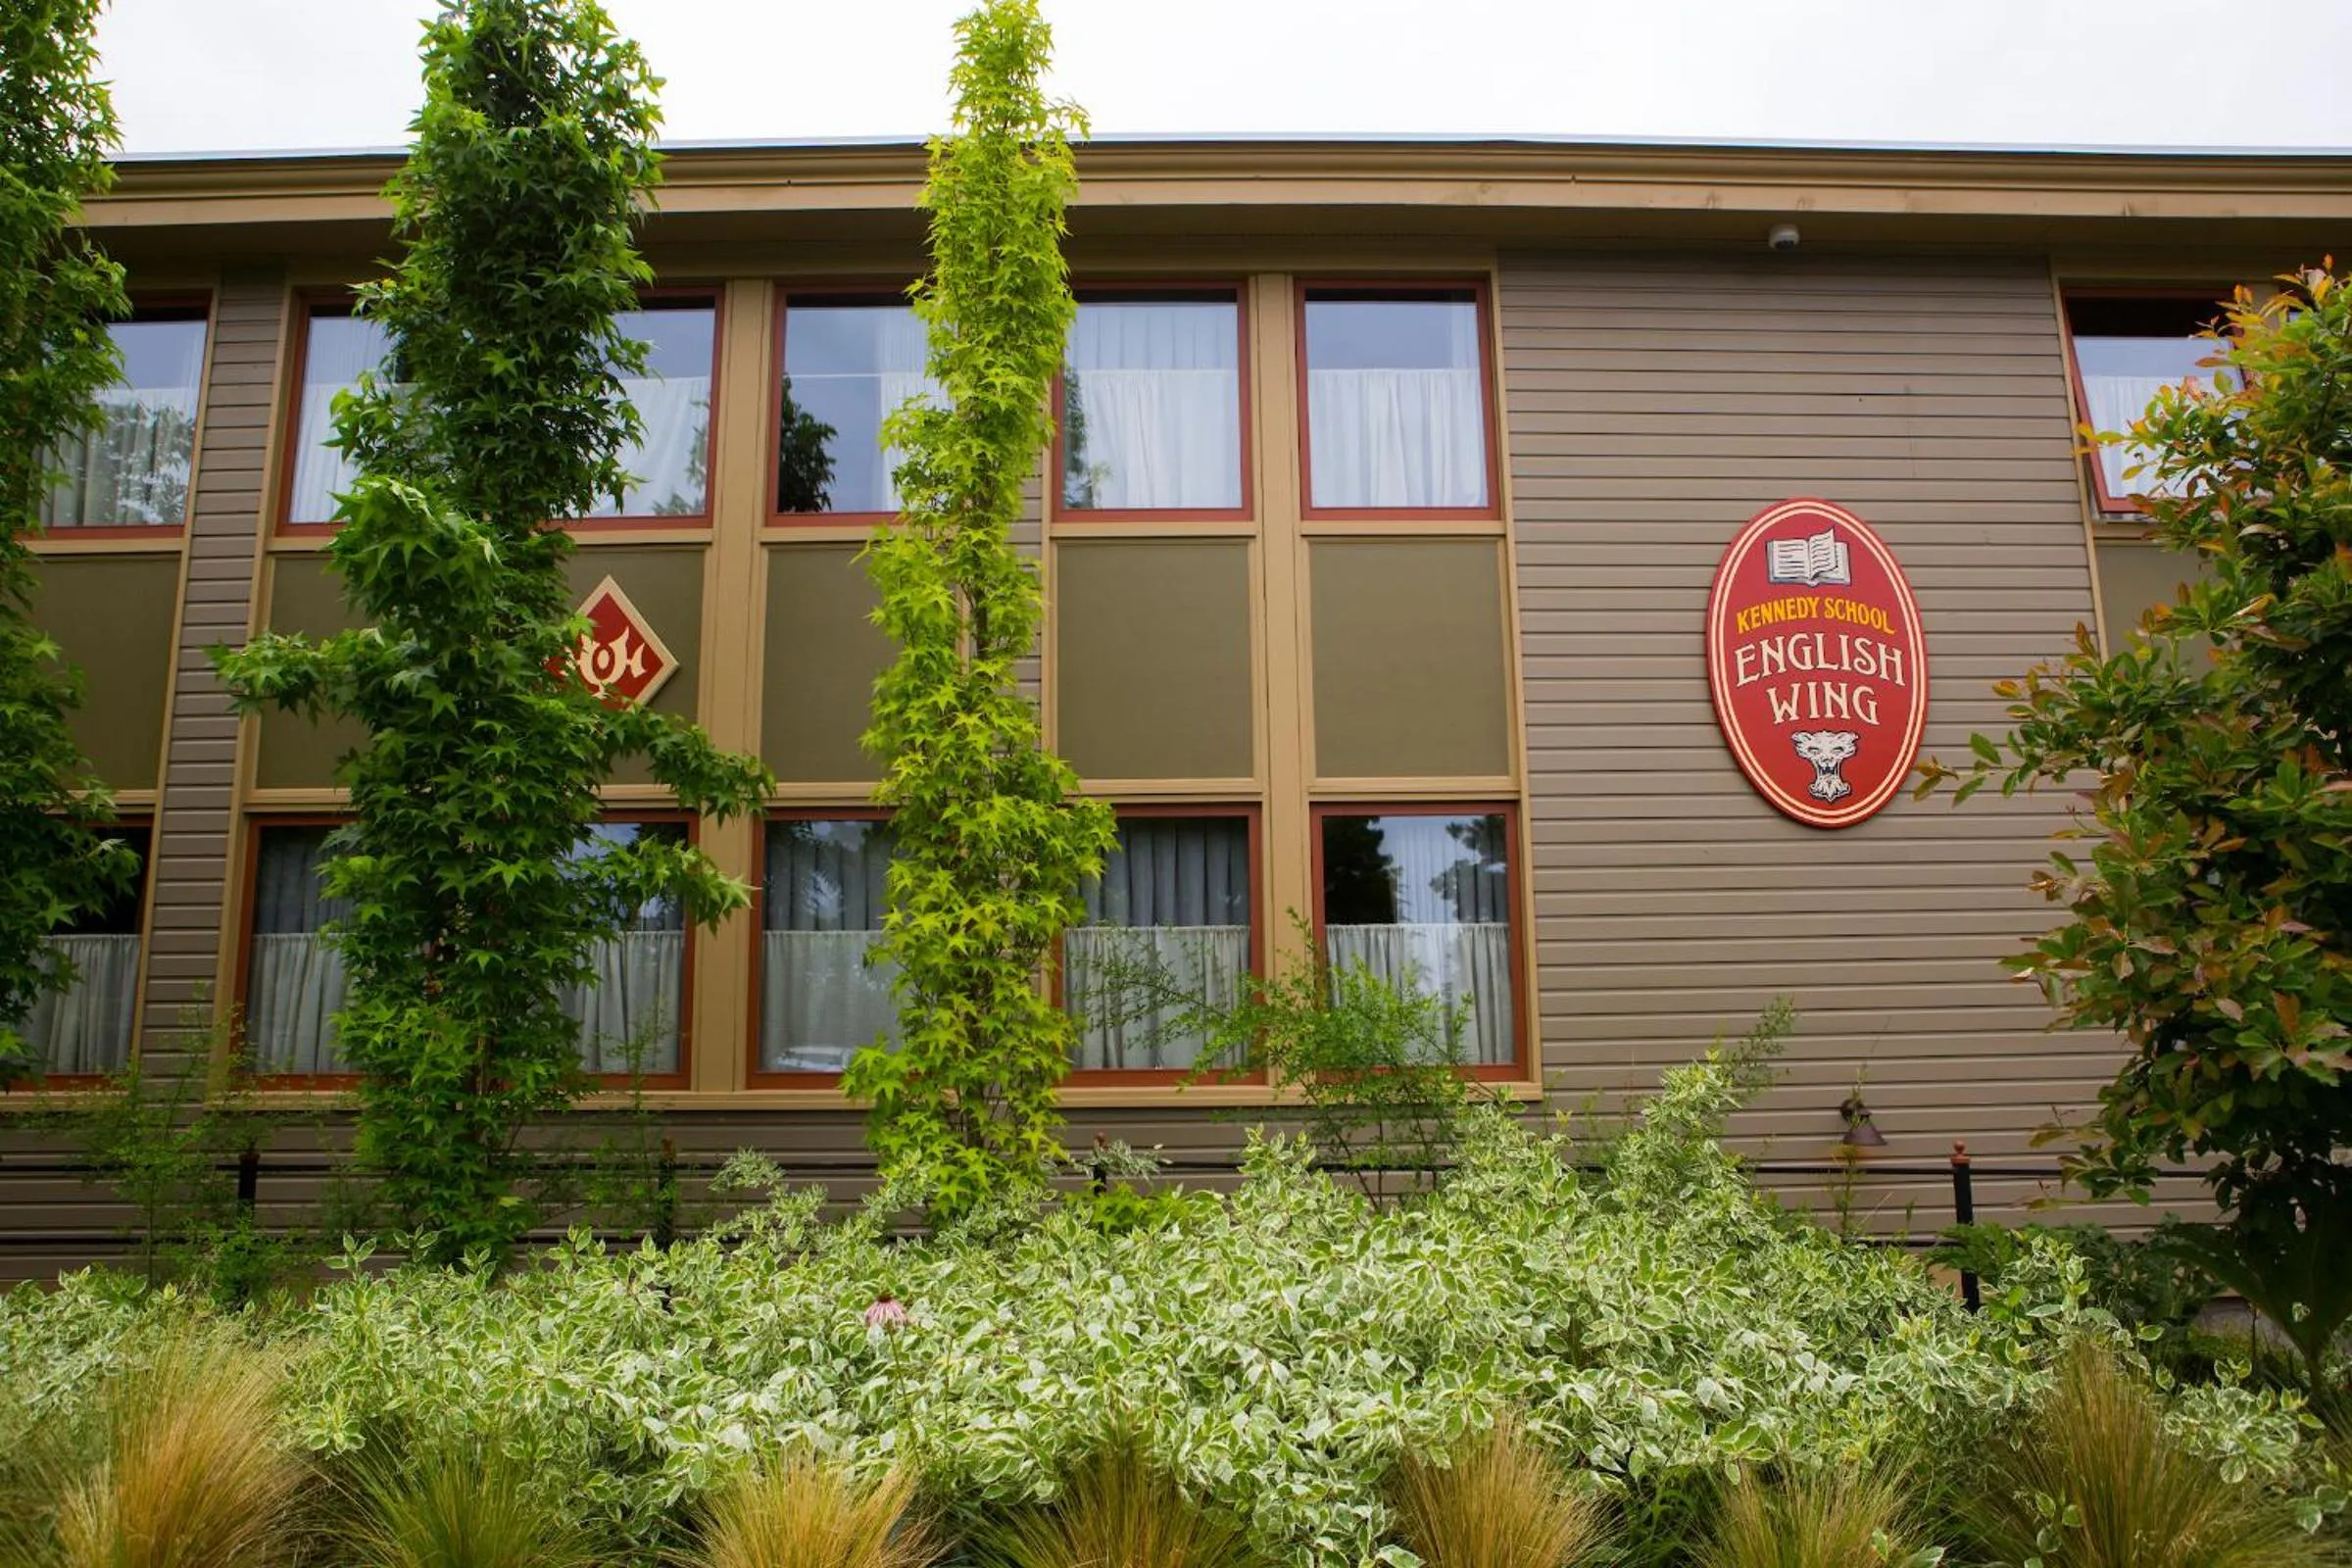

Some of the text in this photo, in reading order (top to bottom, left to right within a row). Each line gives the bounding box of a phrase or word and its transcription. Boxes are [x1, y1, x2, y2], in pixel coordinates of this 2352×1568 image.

[1737, 597, 1895, 635] KENNEDY SCHOOL
[1734, 633, 1905, 687] ENGLISH
[1767, 681, 1881, 725] WING
